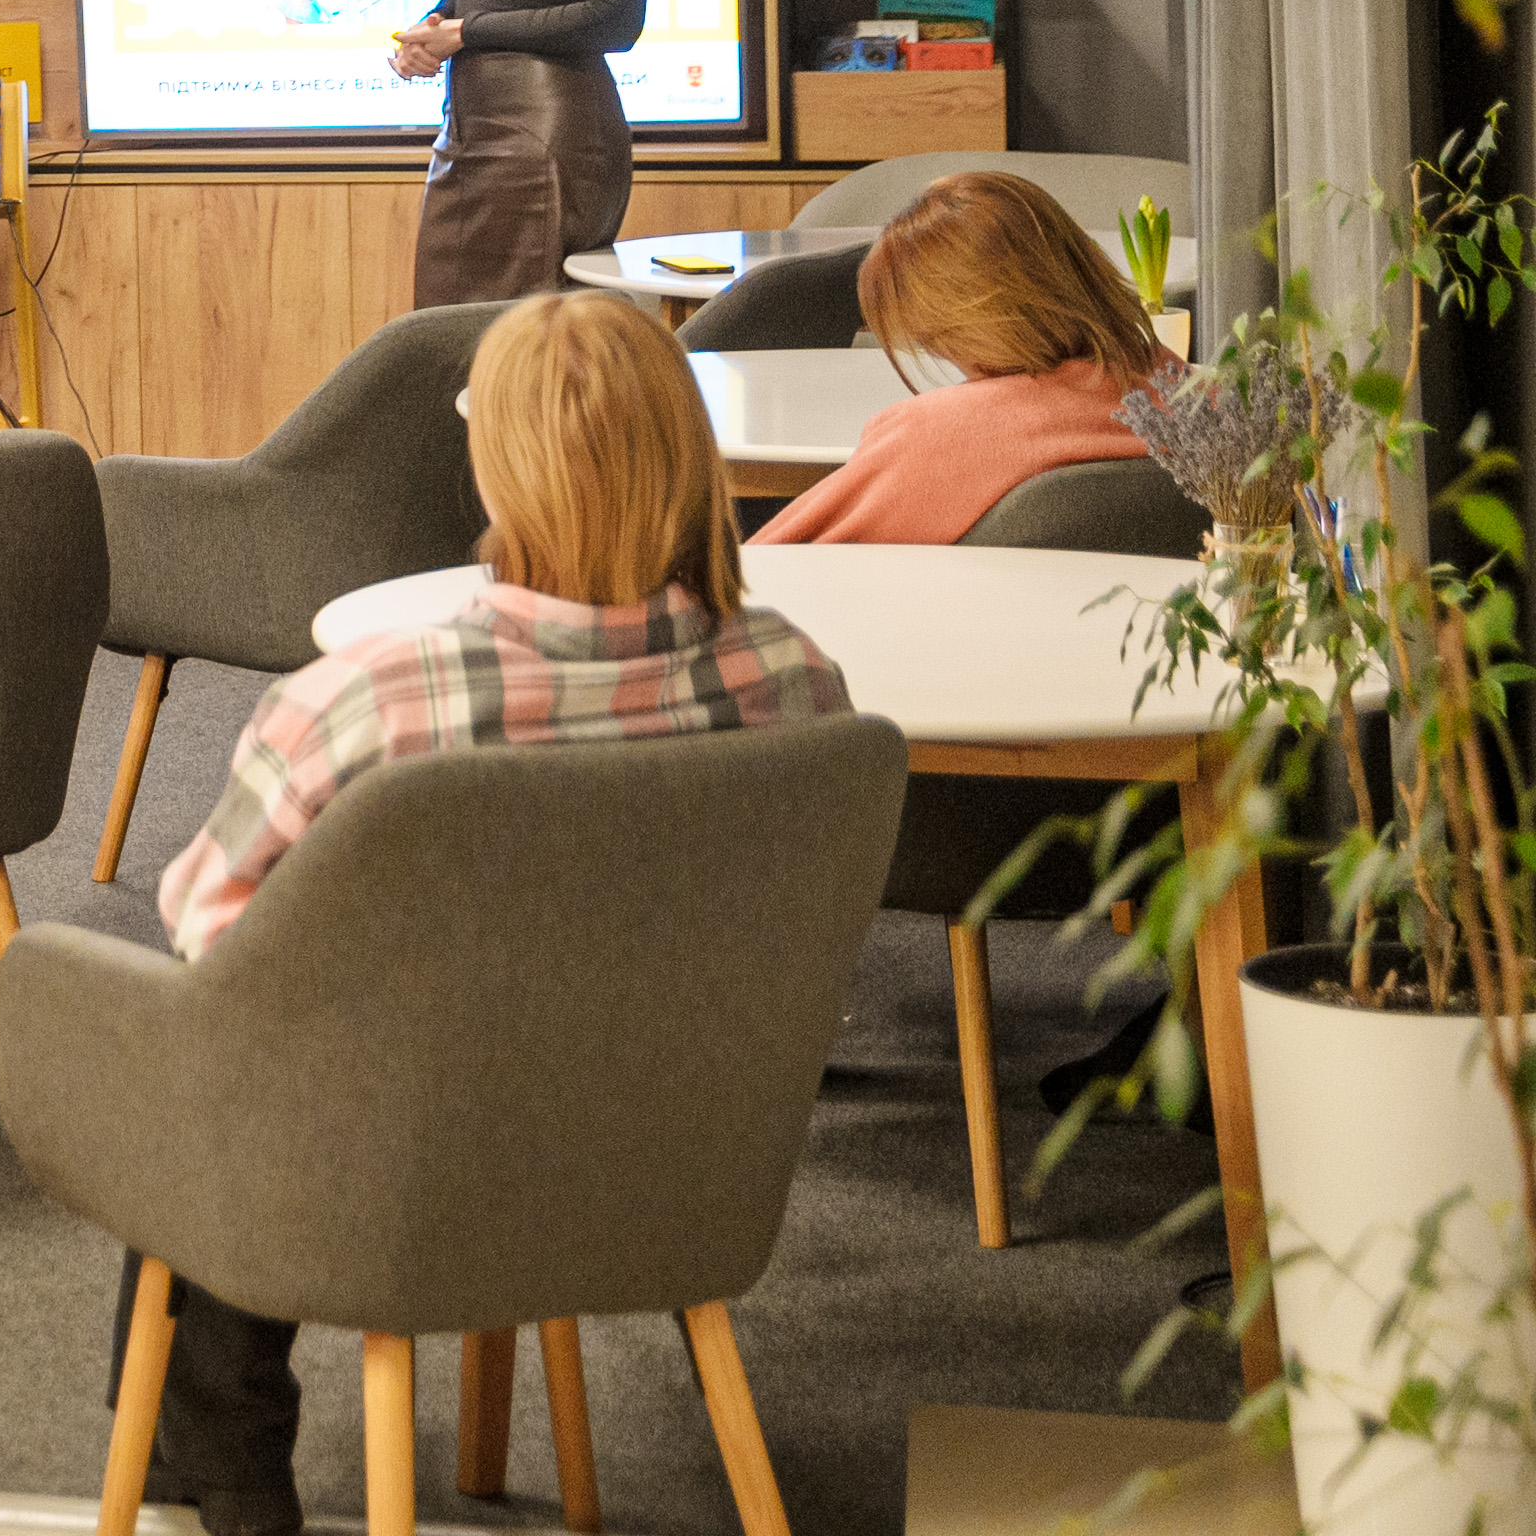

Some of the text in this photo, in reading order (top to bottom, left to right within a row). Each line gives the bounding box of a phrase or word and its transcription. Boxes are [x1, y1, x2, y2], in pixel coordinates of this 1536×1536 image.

[158, 80, 264, 94] ПІДТРИМКА
[272, 78, 346, 92] БІЗНЕСУ
[355, 78, 383, 91] ВІД
